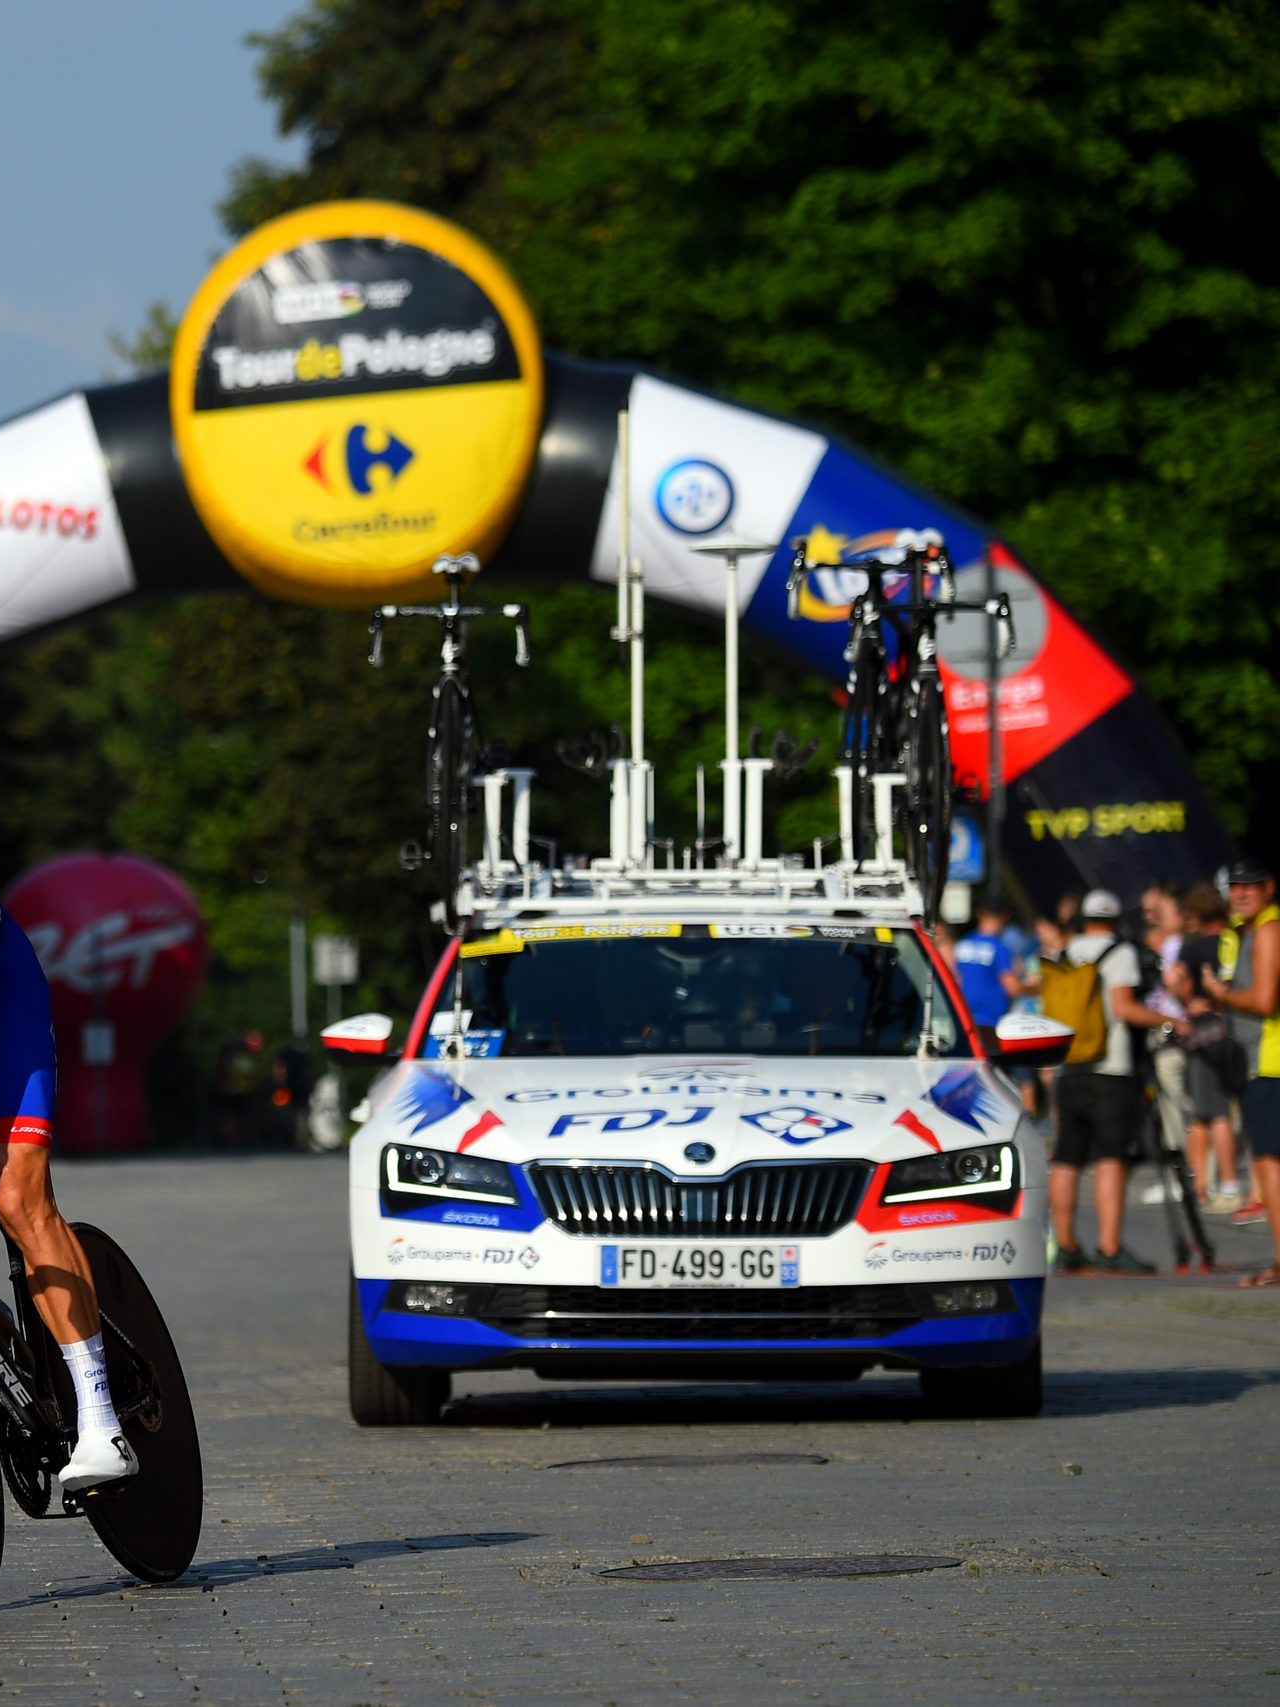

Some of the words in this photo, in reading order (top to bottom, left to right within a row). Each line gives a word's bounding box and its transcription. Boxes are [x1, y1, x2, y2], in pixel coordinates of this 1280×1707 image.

[1092, 802, 1186, 838] SPORT
[725, 925, 776, 936] UCI
[504, 1083, 888, 1105] Groupama
[547, 1106, 717, 1139] FDJ
[407, 1246, 472, 1262] Groupama
[482, 1249, 515, 1265] FDJ
[891, 1249, 963, 1263] Groupama
[972, 1246, 1000, 1261] FDJ
